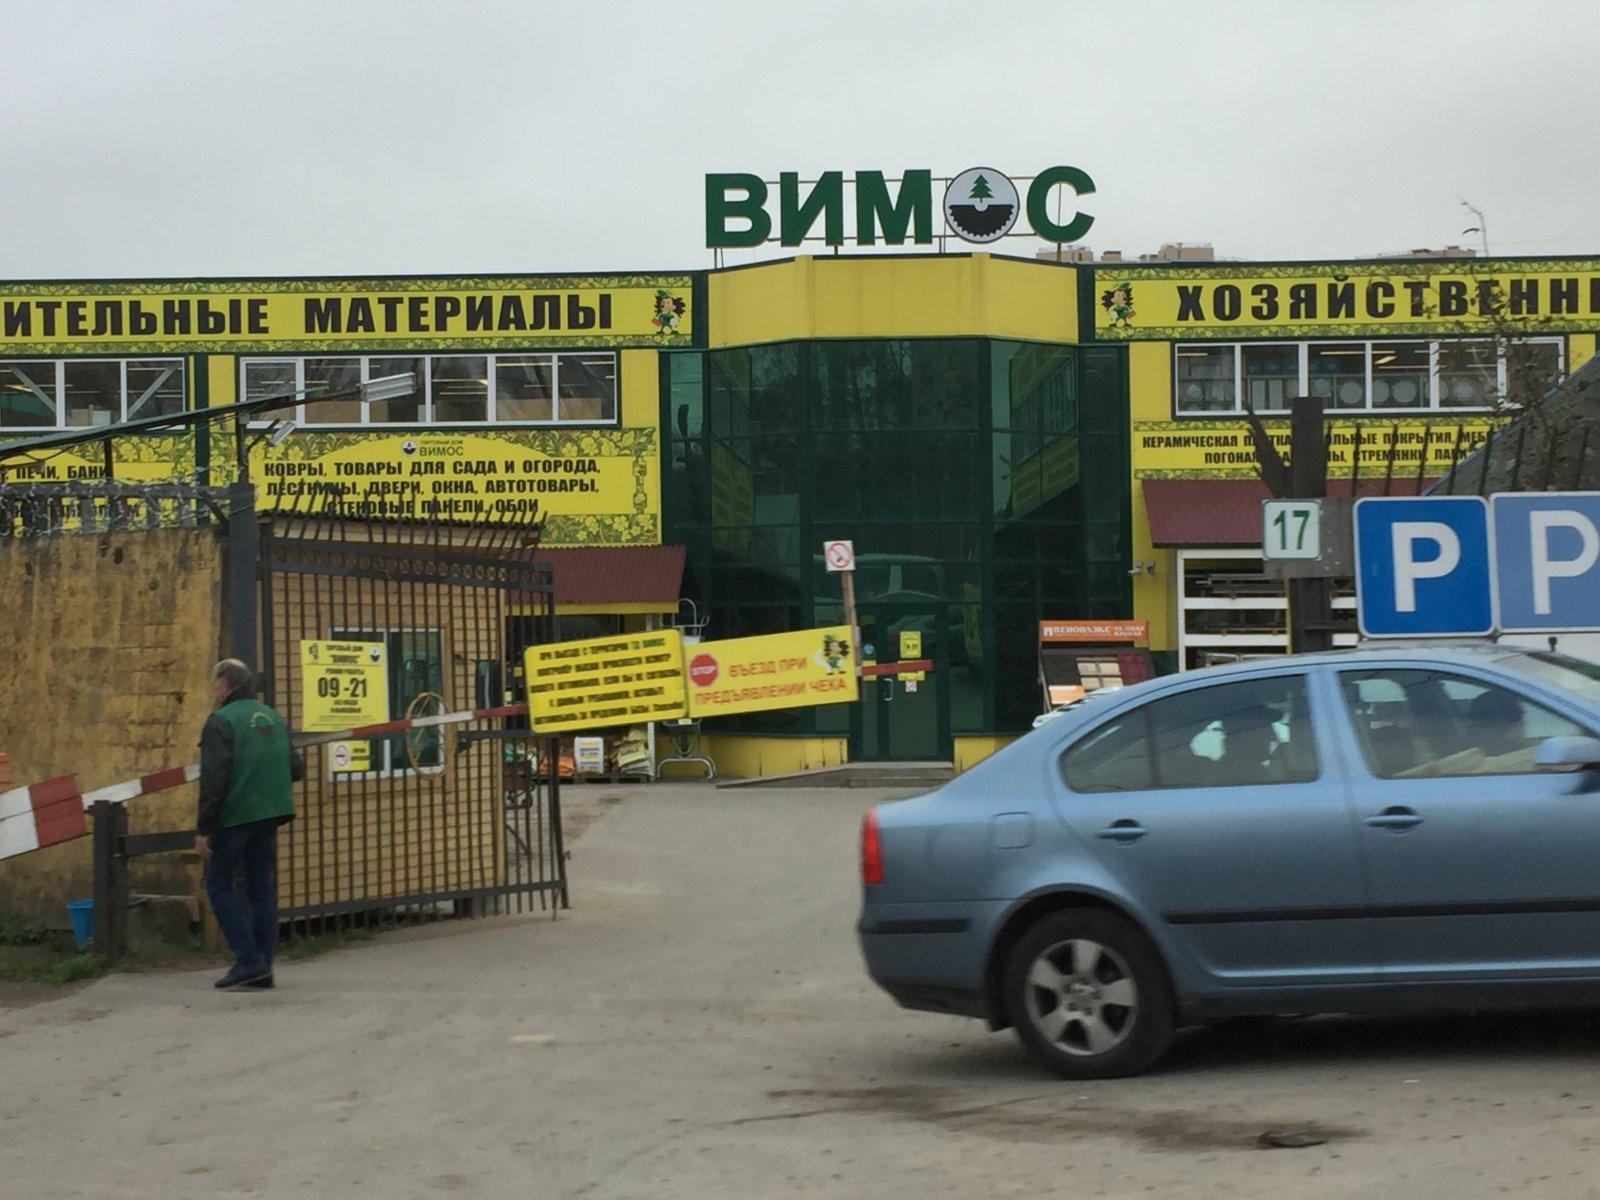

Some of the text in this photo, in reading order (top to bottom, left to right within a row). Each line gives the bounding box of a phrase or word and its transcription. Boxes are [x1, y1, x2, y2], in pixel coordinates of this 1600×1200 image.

[705, 165, 1096, 249] ВИМОС
[1176, 275, 1600, 322] ХОЗЯЙСТВЕНН
[4, 293, 612, 337] ИТЕЛЬНЫЕ МАТЕРИАЛЫ
[419, 446, 464, 457] ВИМОС
[1142, 435, 1238, 449] КЕРАМИЧЕСКАЯ
[264, 459, 601, 477] КОВРЫ, ТОВАРЫ ДЛЯ САДА И ОГОРОДА,
[366, 481, 424, 496] ДВЕРИ,
[432, 480, 478, 495] ОКНА,
[485, 478, 599, 494] АВТОТОВАРЫ,
[495, 498, 539, 513] ОБОИ
[1271, 509, 1311, 551] 17
[1390, 521, 1462, 613] P
[1529, 509, 1600, 615] P
[728, 656, 809, 678] ВЪЕЗД ПРИ
[809, 678, 846, 693] ЧЕКА
